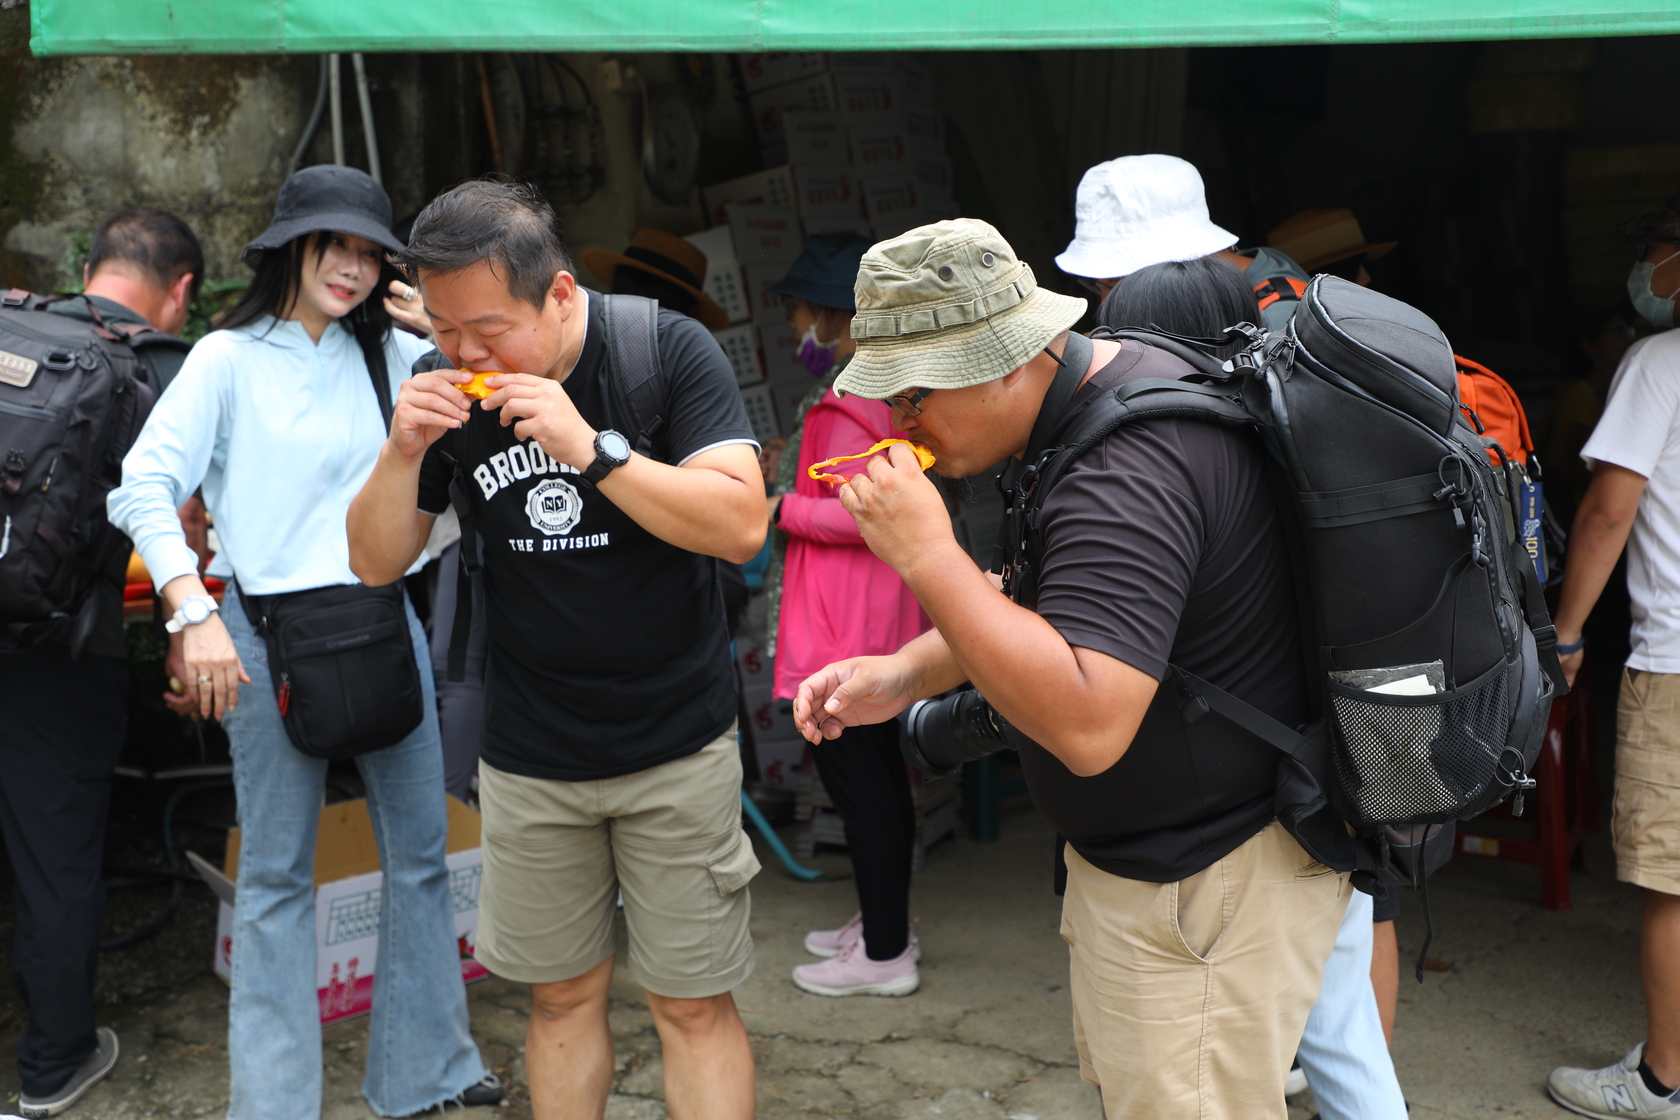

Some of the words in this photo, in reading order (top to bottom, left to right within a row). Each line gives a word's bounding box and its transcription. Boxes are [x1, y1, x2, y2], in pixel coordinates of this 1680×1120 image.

[473, 440, 581, 501] BROO
[538, 482, 567, 493] COLLEGE
[540, 520, 572, 530] UNIVERSITY
[508, 538, 534, 552] THE
[542, 532, 610, 552] DIVISION
[1525, 536, 1539, 559] 100
[1601, 1084, 1637, 1112] N
